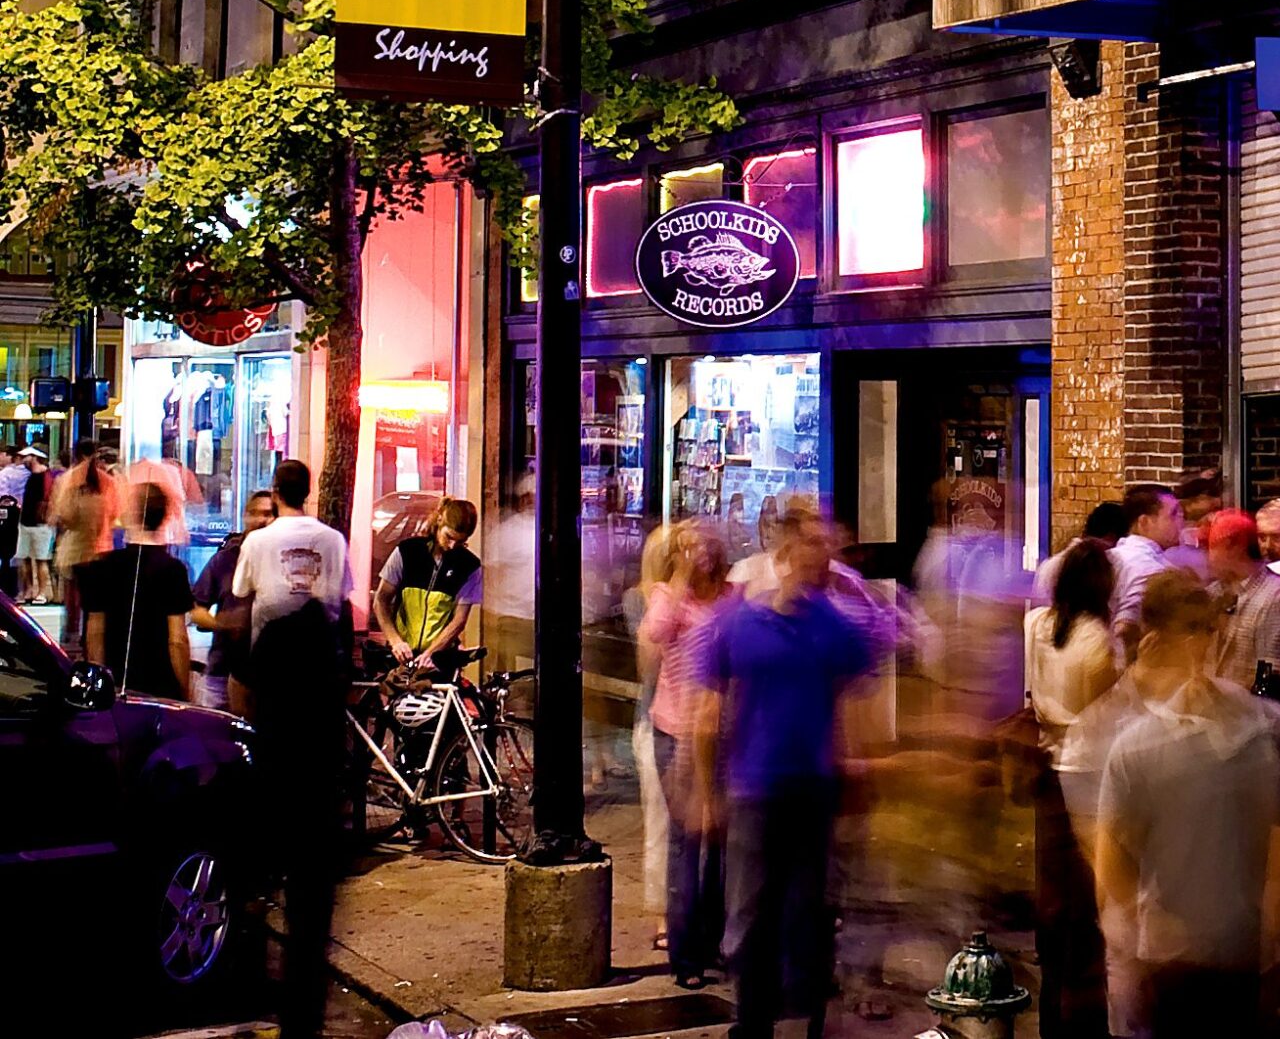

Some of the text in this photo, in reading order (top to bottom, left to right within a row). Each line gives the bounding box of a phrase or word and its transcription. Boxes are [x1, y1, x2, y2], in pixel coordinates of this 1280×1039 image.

[374, 28, 488, 77] Shopping
[657, 211, 780, 245] SCHOOLKIDS
[672, 288, 764, 317] RECORDS
[180, 311, 263, 345] OPTICS
